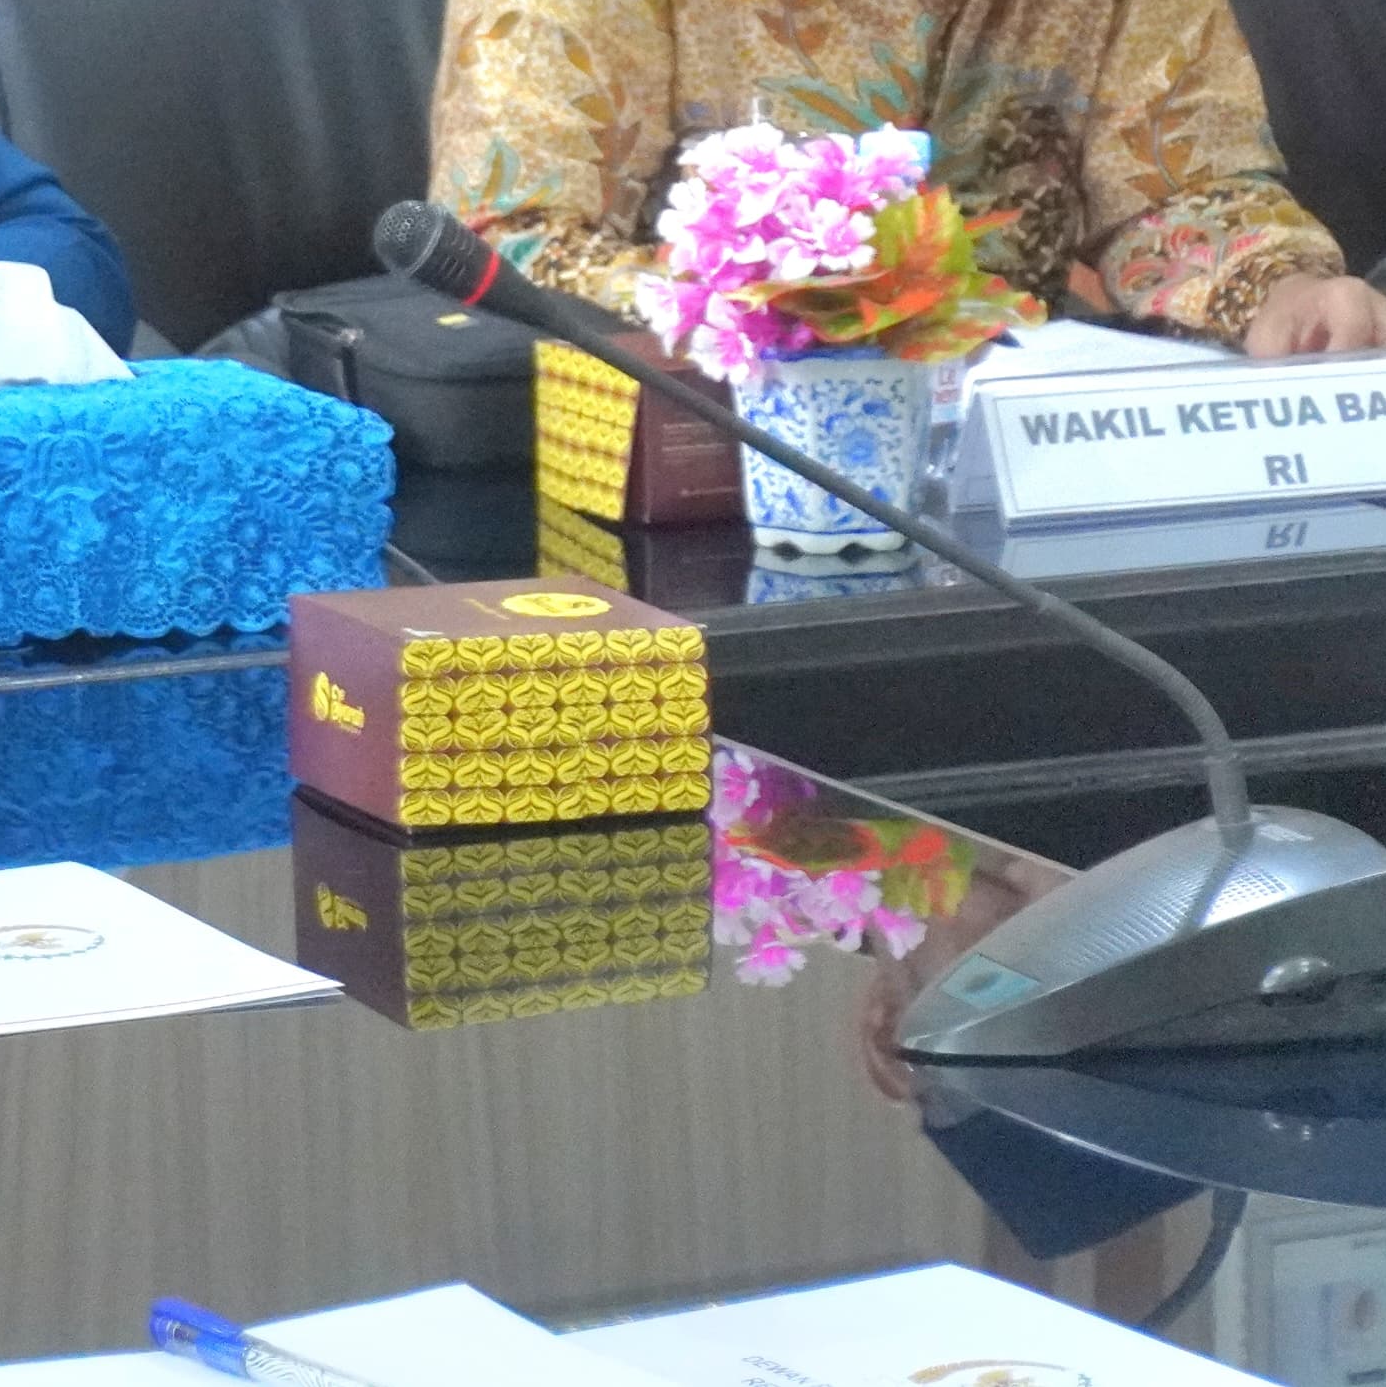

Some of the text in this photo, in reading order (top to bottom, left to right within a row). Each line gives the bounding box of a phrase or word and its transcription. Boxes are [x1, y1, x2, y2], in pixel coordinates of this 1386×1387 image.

[1020, 405, 1166, 446] WAKIL
[1176, 395, 1327, 435] KETUA
[1263, 453, 1309, 487] RI
